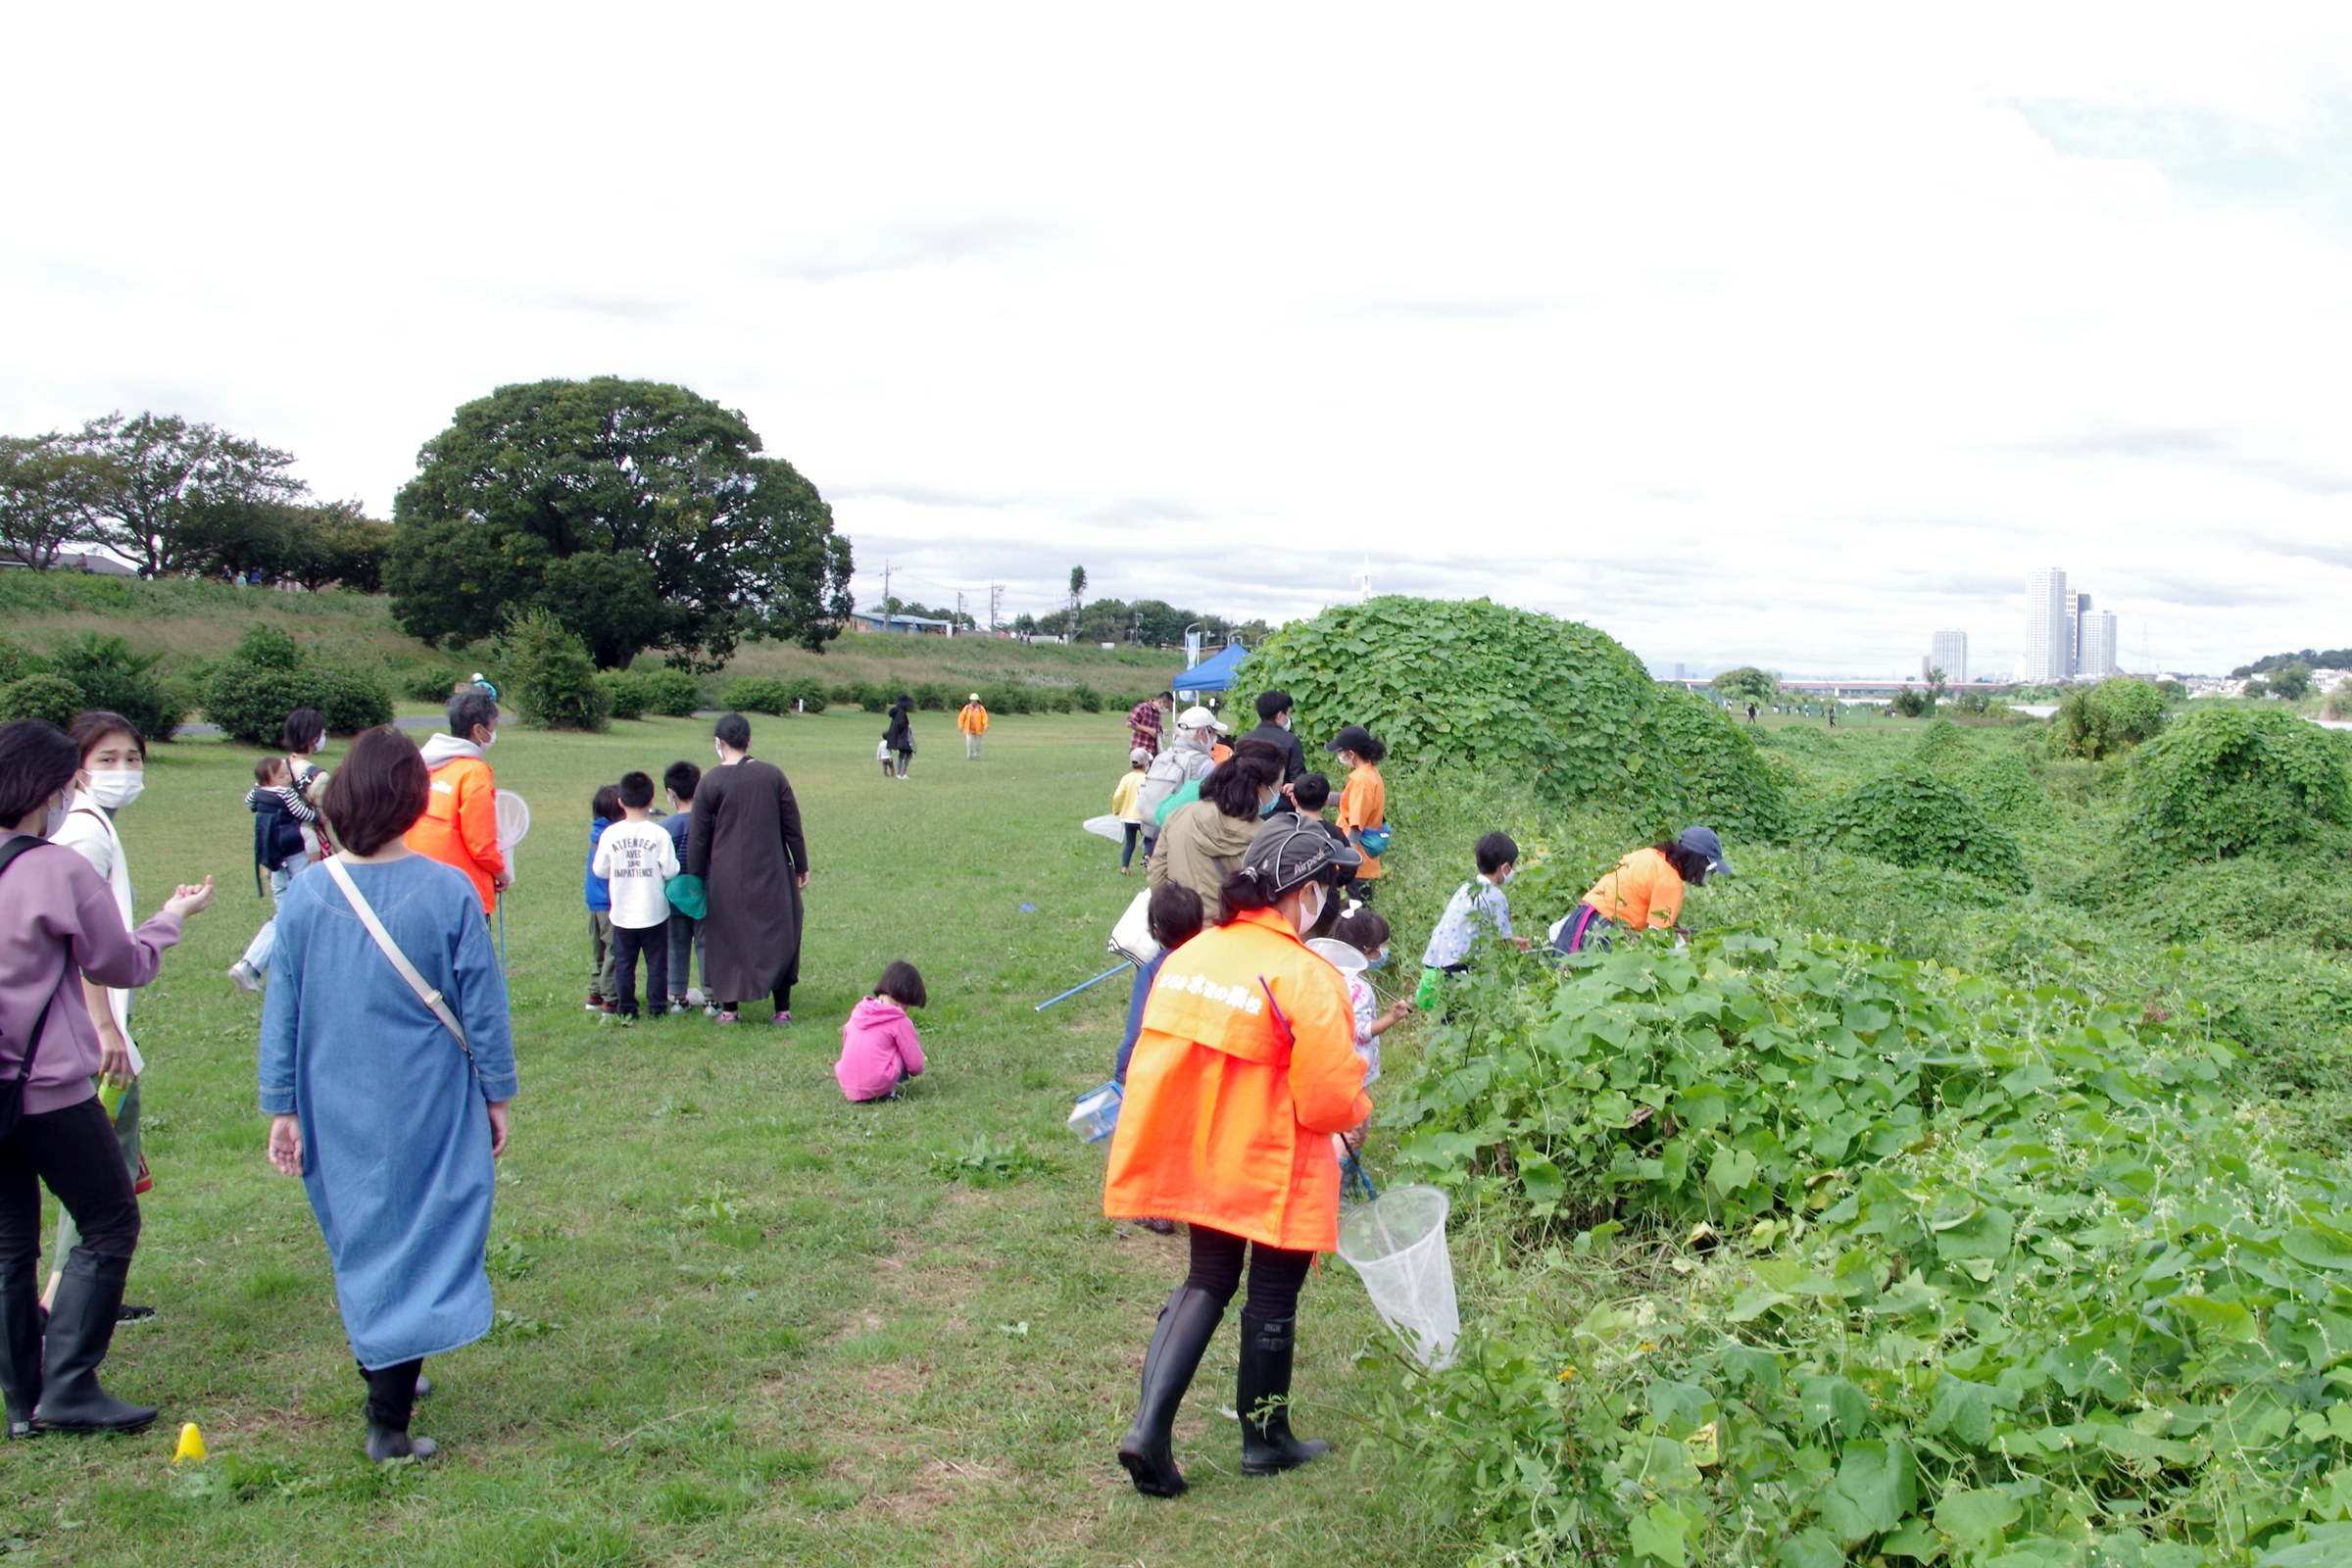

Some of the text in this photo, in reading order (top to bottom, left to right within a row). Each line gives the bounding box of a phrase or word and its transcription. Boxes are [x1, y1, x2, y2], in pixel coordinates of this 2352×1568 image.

[612, 838, 657, 853] ATTENDER
[626, 850, 641, 858] AVEC
[1294, 848, 1325, 875] Airpeak
[614, 868, 653, 877] IMPATIENCE
